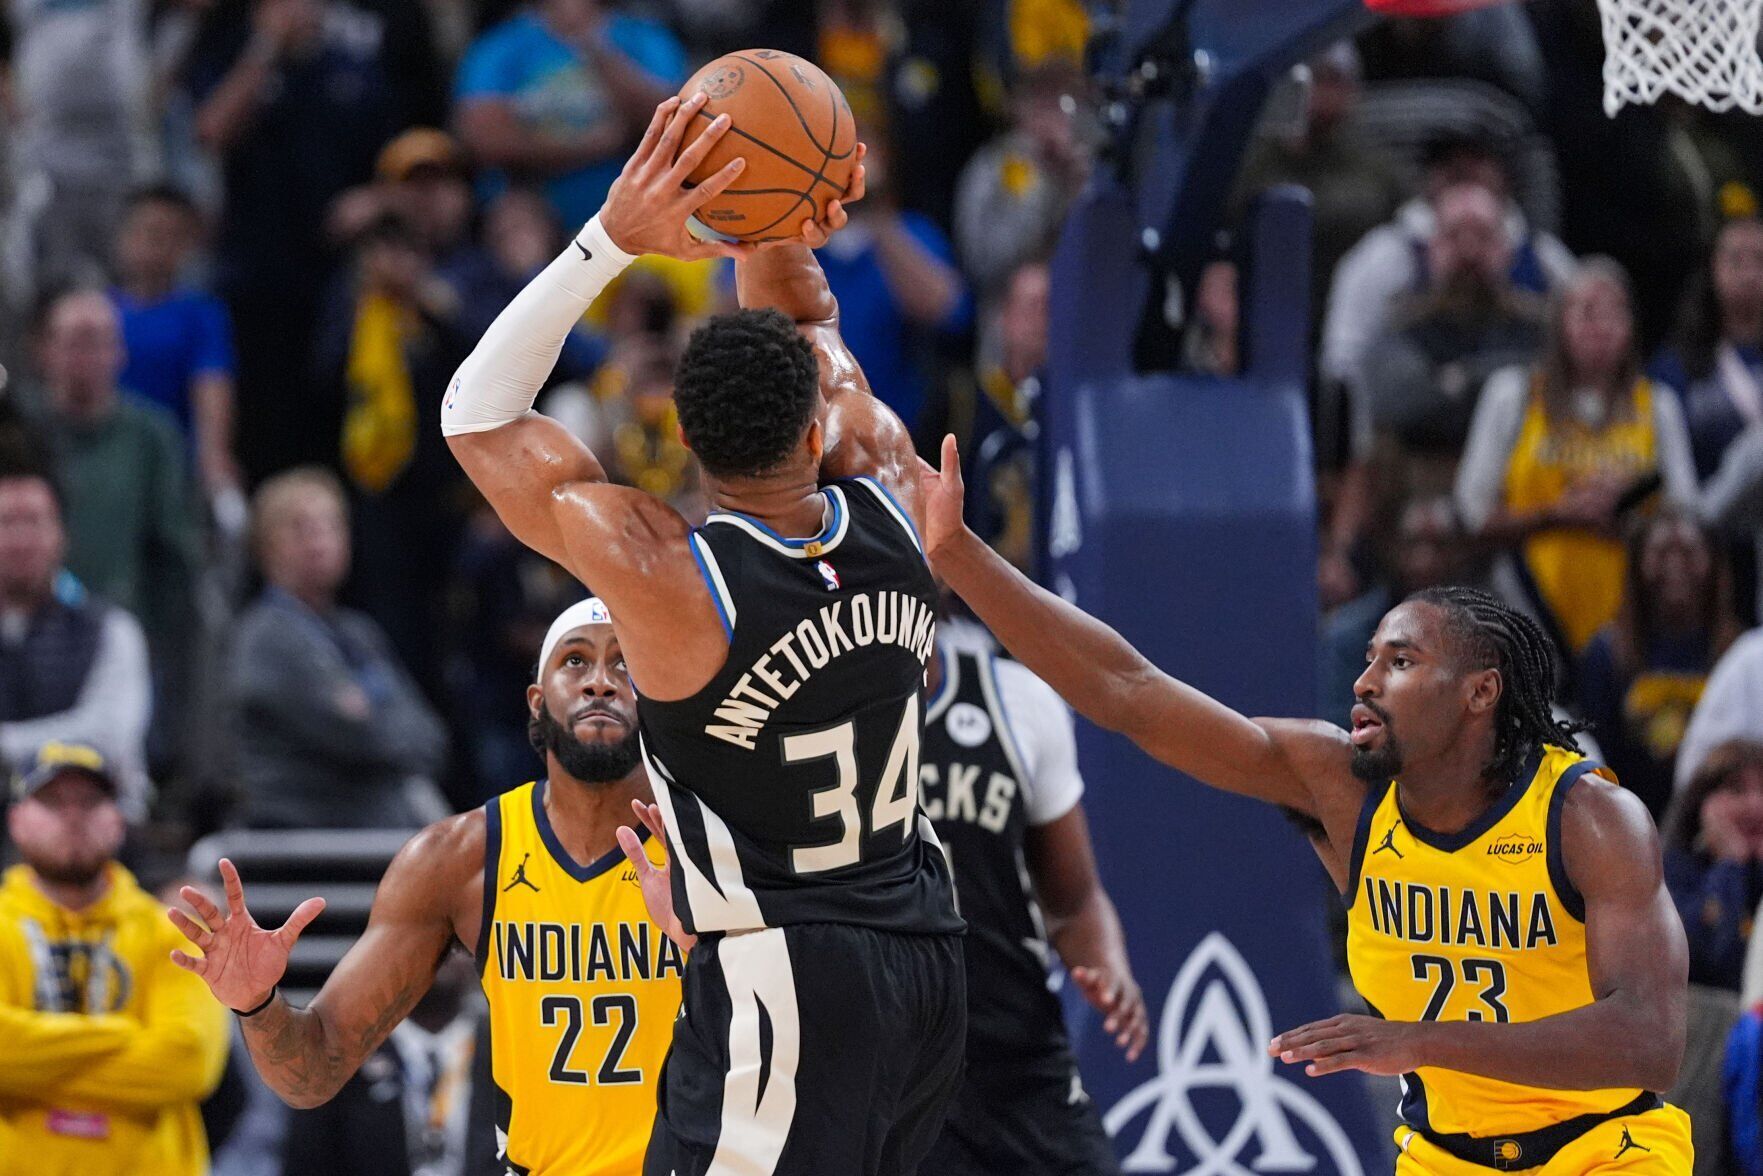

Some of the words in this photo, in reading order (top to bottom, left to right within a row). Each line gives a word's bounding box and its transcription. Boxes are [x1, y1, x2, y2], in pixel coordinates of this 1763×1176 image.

[783, 690, 919, 874] 34
[918, 762, 1017, 834] CKS
[1487, 843, 1524, 855] LUCAS
[1526, 842, 1543, 854] OIL
[1365, 875, 1558, 950] INDIANA
[493, 921, 684, 982] INDIANA
[1410, 953, 1510, 1023] 23
[540, 993, 644, 1087] 22
